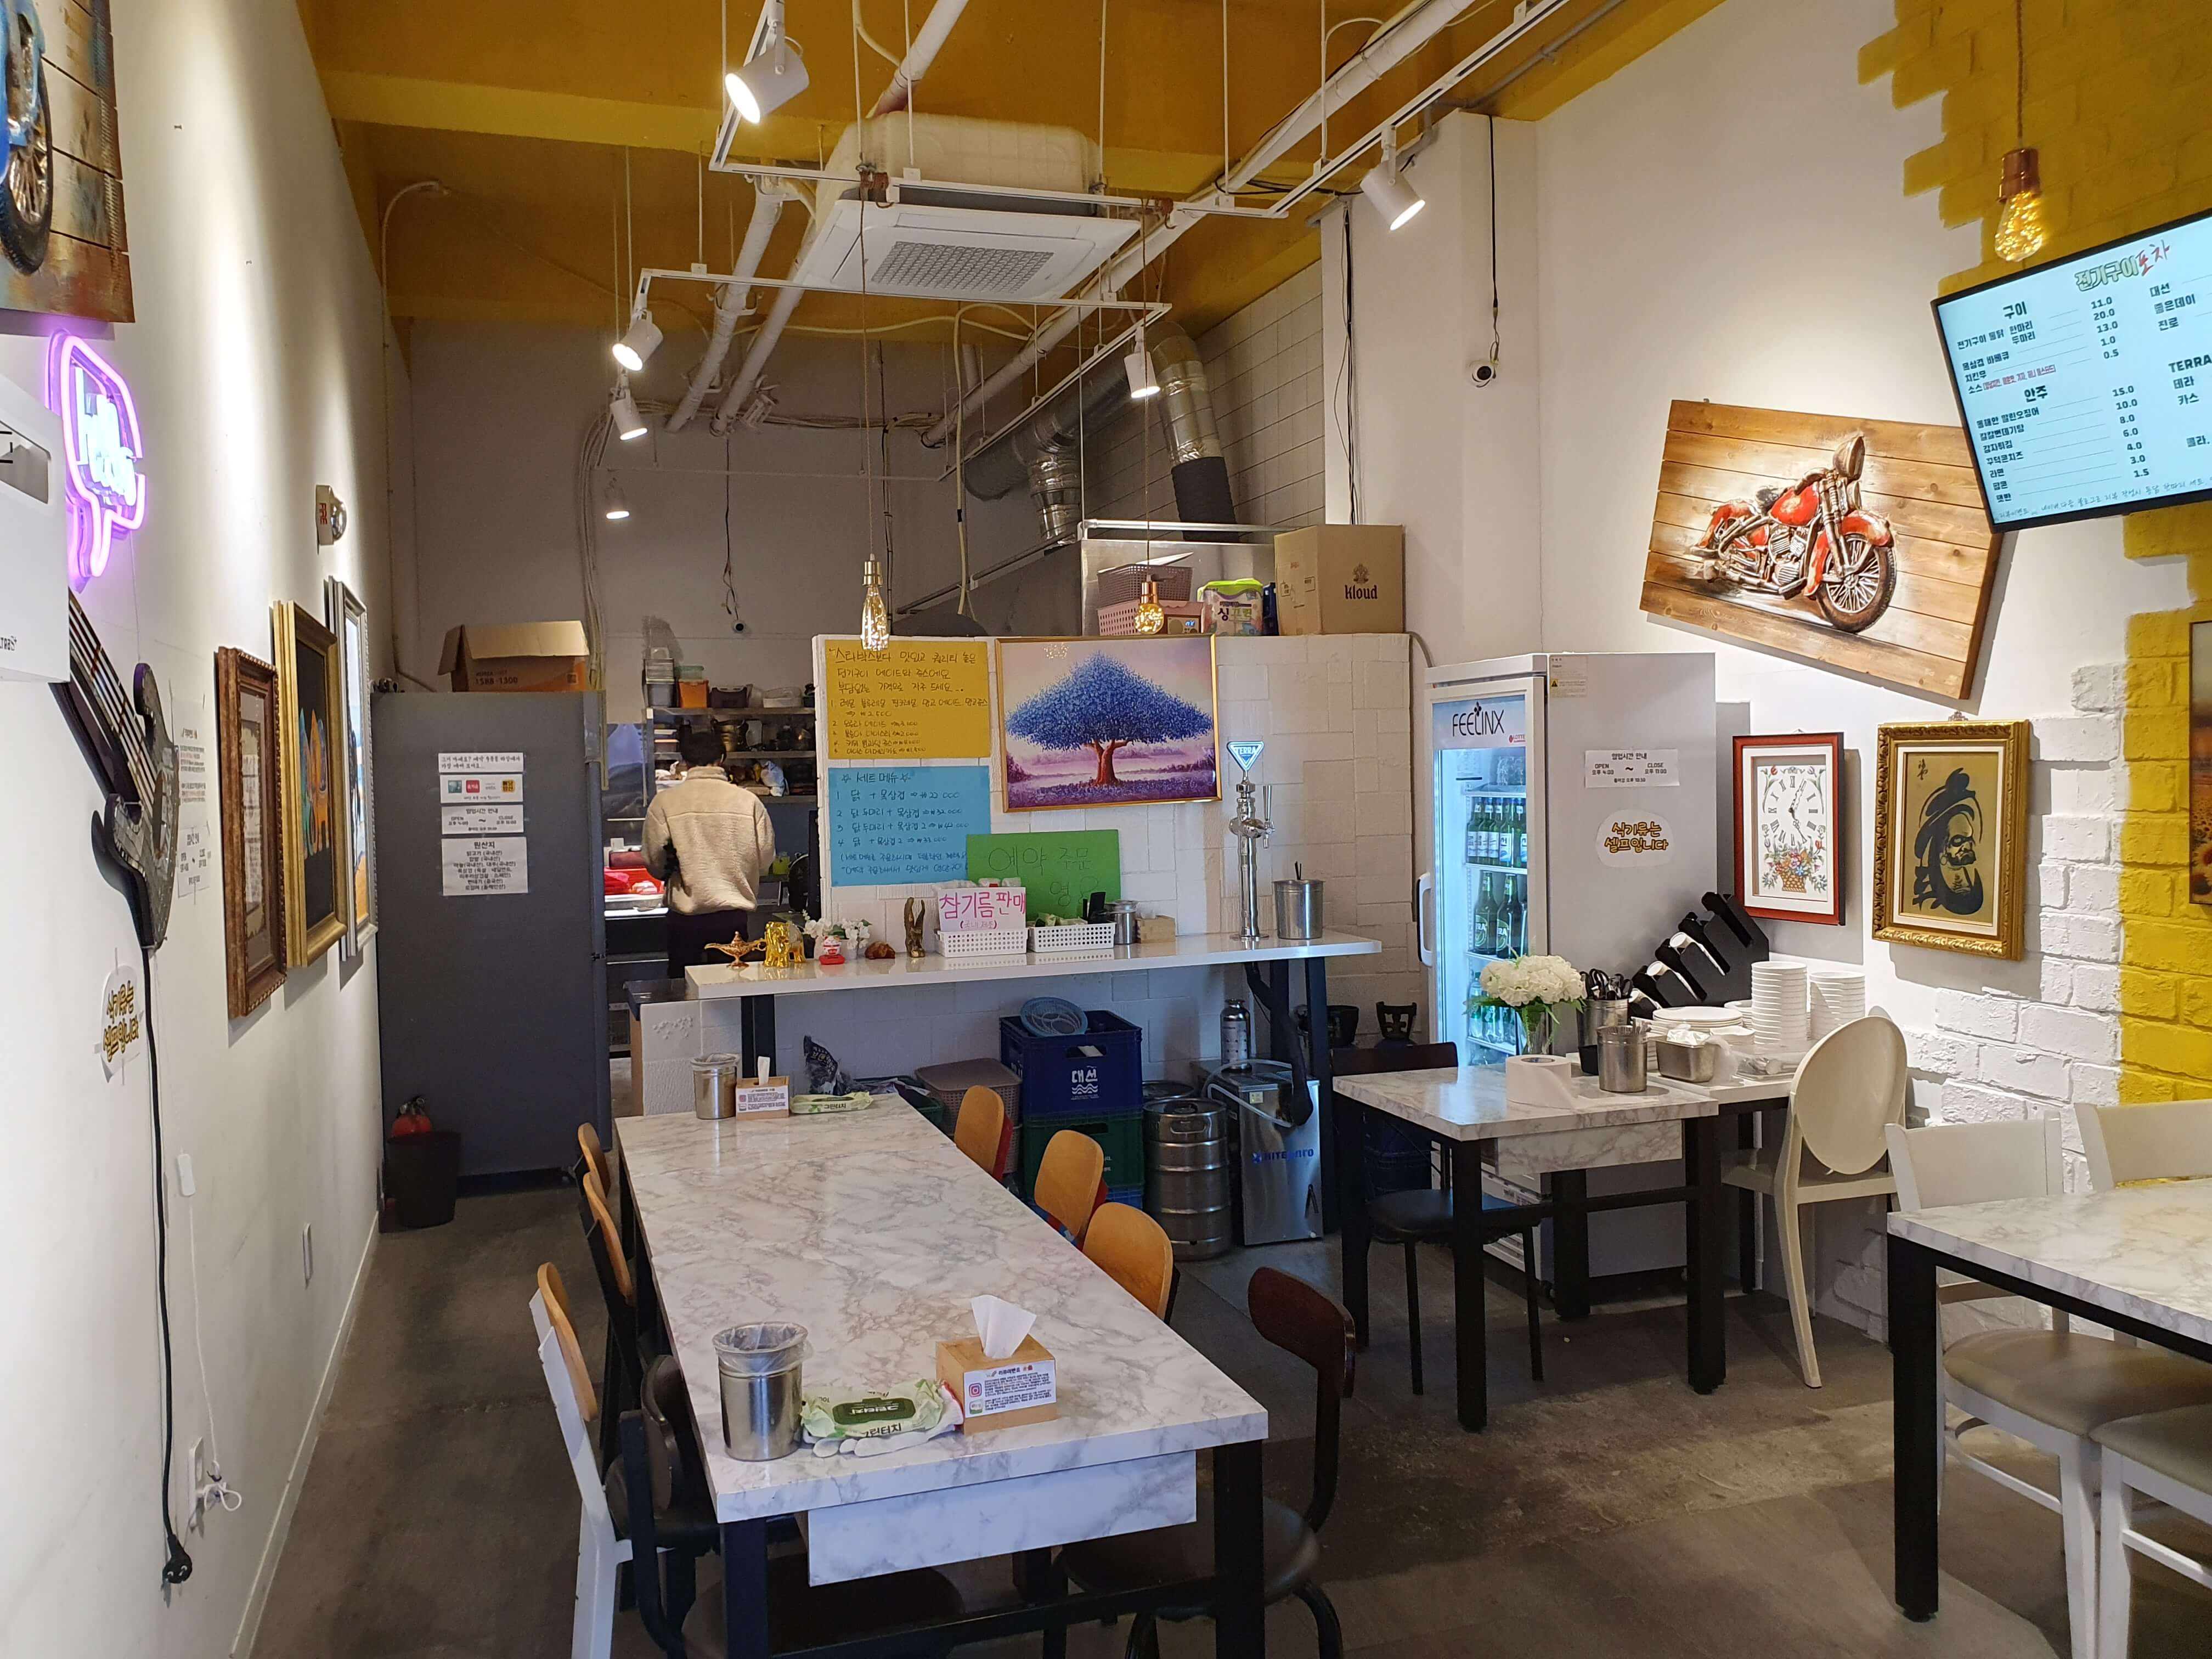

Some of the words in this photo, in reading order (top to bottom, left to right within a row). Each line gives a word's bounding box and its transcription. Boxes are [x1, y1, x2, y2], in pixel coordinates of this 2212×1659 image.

[2149, 283, 2170, 297] 대선
[2003, 301, 2027, 319] 구이
[1957, 334, 1987, 349] 전기구이
[2010, 320, 2033, 335] 한마리
[2091, 296, 2113, 309] 11.0
[2012, 331, 2035, 345] 두마리
[2094, 308, 2115, 320] 20.0
[2158, 317, 2179, 331] 진로
[1962, 358, 1985, 371] 목삼겹
[2096, 321, 2118, 333] 13.0
[1965, 370, 1987, 383] 치킨무
[2101, 336, 2116, 346] 1.0
[2168, 354, 2212, 373] TERRA
[1968, 385, 1983, 394] 소스
[2103, 349, 2119, 359] 0.5
[2173, 375, 2194, 390] 테라
[2024, 385, 2048, 403] 안주
[2112, 385, 2134, 397] 15.0
[2177, 392, 2199, 405] 카스
[2116, 398, 2137, 410] 10.0
[1983, 439, 2013, 454] 감자튀김
[2119, 414, 2135, 424] 8.0
[2123, 427, 2138, 437] 6.0
[1989, 468, 2005, 478] 라면
[2126, 442, 2142, 451] 4.0
[1993, 481, 2008, 490] 팝콘
[2130, 455, 2146, 465] 3.0
[1996, 493, 2012, 503] 햇반
[2134, 468, 2149, 478] 1.5
[900, 651, 926, 663] 맛있고
[963, 652, 976, 664] 높은
[876, 668, 911, 677] 에이드와
[838, 681, 870, 694] 부담없는
[878, 682, 904, 691] 가격으로
[912, 682, 927, 691] 자주
[840, 698, 855, 708] 레몬
[1452, 709, 1505, 737] FEELINX
[856, 771, 876, 783] 세트
[879, 771, 899, 784] 메뉴
[1612, 821, 1662, 837] 식기류는
[474, 841, 495, 849] 원산지
[1604, 837, 1669, 853] 셀프입니다
[989, 845, 1047, 876] 예약
[1059, 848, 1092, 870] 주문
[939, 891, 995, 920] 참기름
[996, 890, 1026, 916] 판매
[1071, 1068, 1098, 1083] 대선
